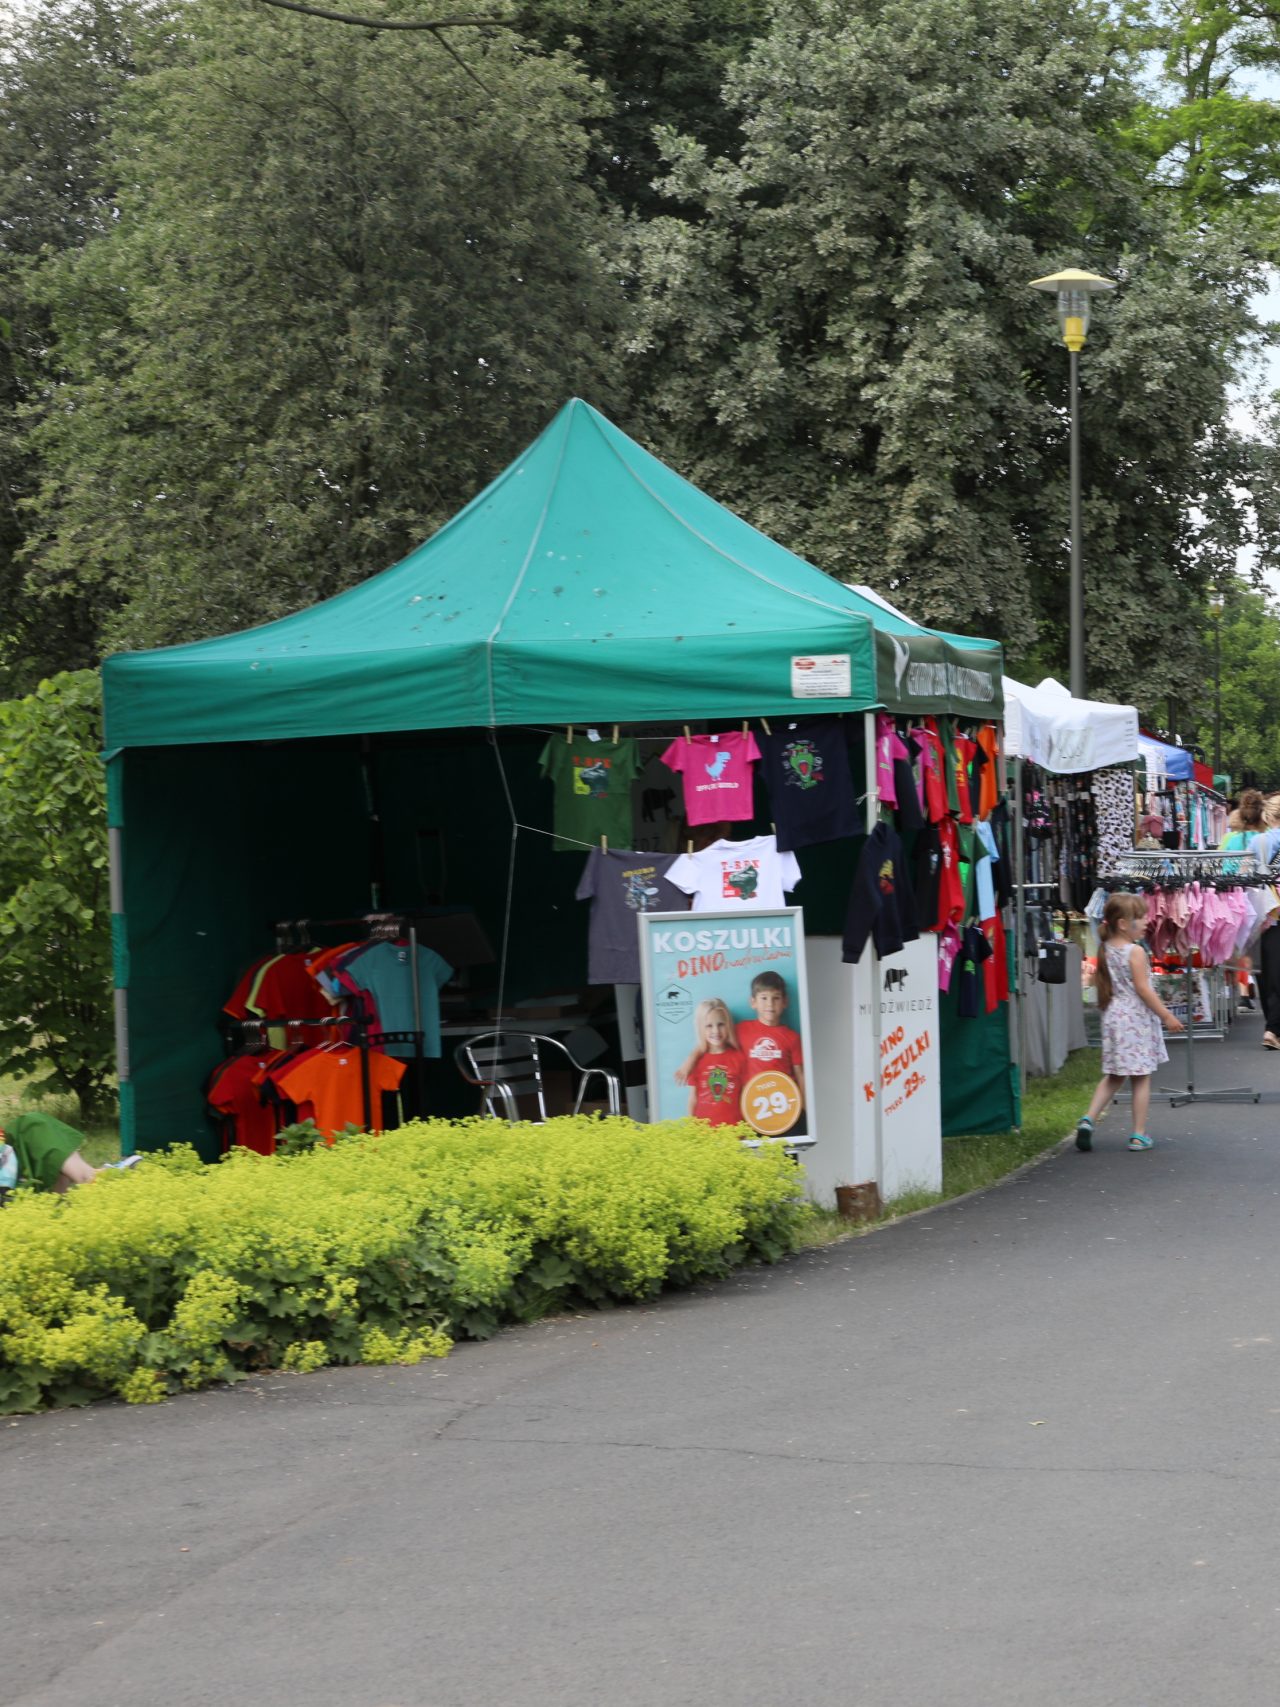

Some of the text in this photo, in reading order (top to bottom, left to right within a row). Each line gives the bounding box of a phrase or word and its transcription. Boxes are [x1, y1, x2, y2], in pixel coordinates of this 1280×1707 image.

[653, 927, 792, 953] KOSZULKI
[677, 951, 726, 979] DINO
[859, 997, 932, 1016] MIDŹWIEDŹ
[863, 1030, 931, 1102] KSZULKI
